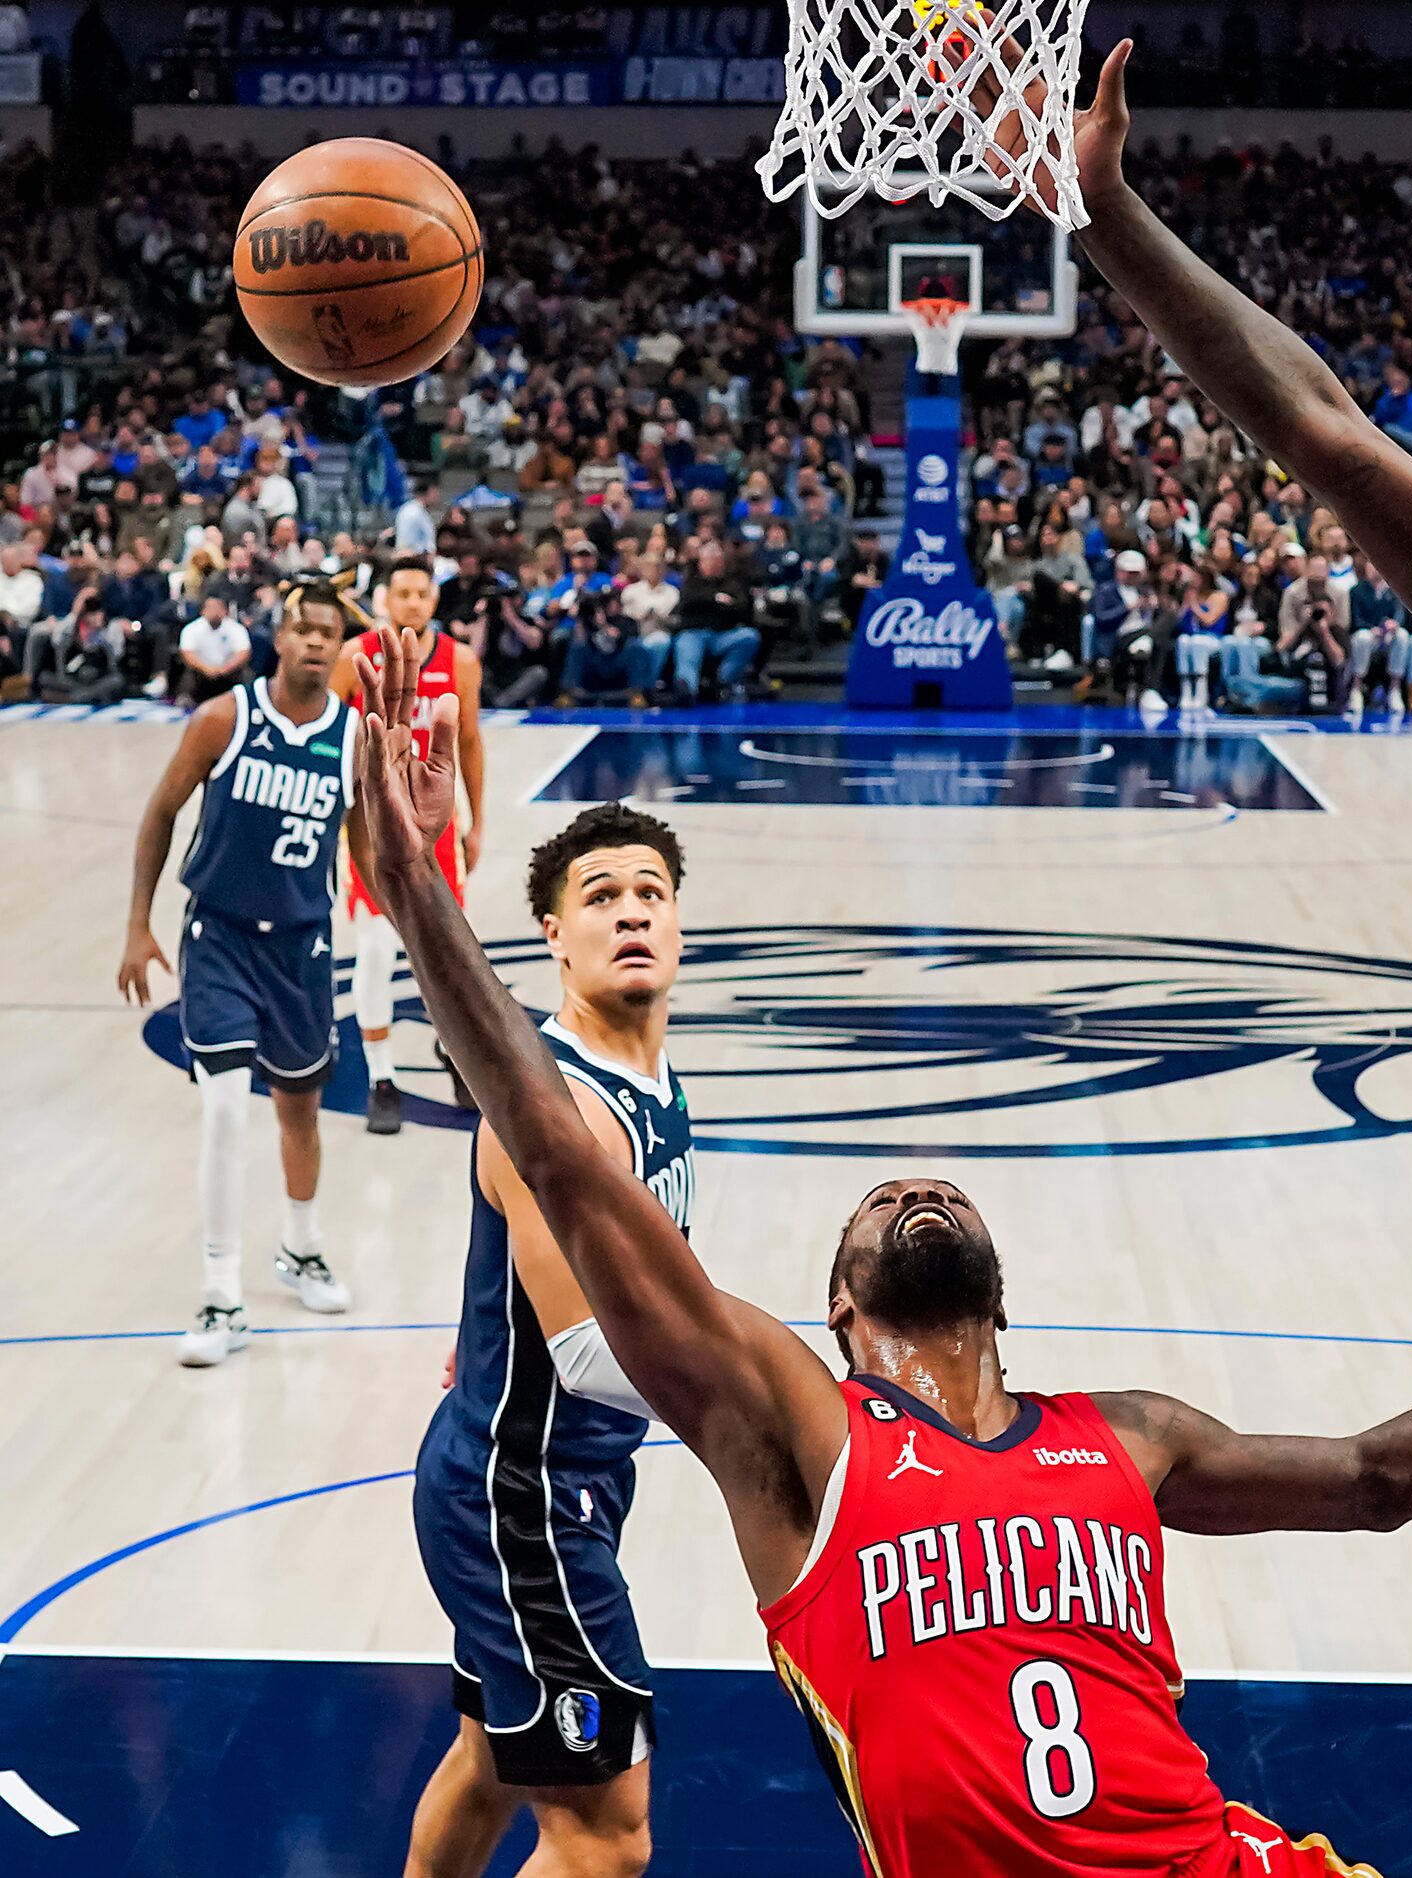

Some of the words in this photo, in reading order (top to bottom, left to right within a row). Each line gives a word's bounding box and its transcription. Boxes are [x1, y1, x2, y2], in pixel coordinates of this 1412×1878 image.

[259, 72, 409, 101] SOUND
[439, 72, 590, 101] STAGE
[249, 218, 410, 275] Wilson
[866, 597, 993, 660] Bally
[271, 815, 326, 869] 25
[617, 1088, 637, 1113] 6
[869, 1399, 897, 1420] 6
[1032, 1447, 1109, 1467] ibotta
[857, 1514, 1154, 1661] PELICANS
[1008, 1657, 1098, 1819] 8
